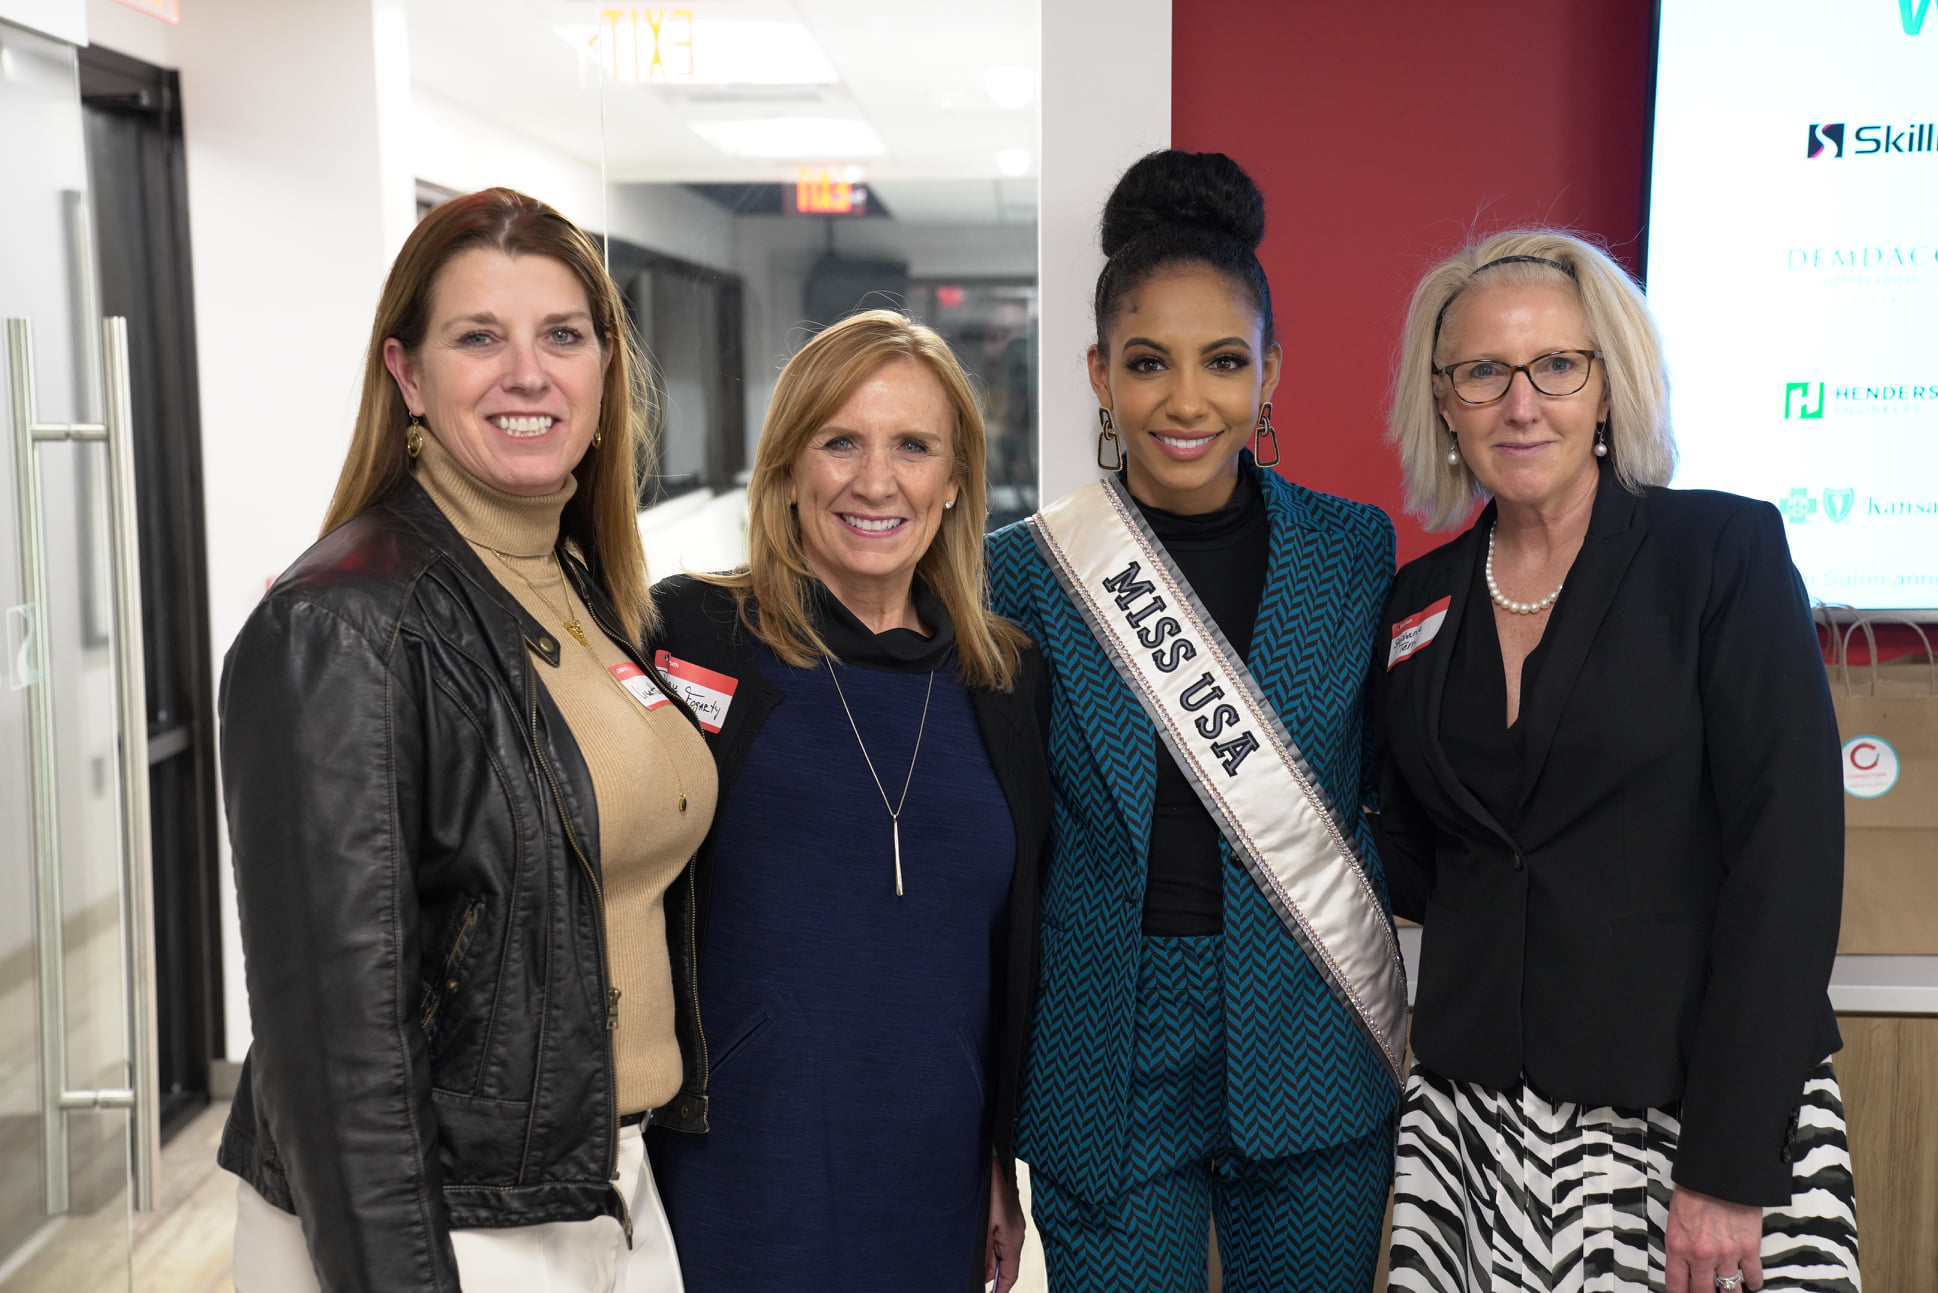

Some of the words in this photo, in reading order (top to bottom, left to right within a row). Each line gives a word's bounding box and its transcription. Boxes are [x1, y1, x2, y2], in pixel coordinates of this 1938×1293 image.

[1855, 123, 1938, 154] Skill
[1787, 245, 1938, 269] DEMDAC
[1823, 570, 1886, 587] Salon
[1892, 575, 1938, 586] ann
[1102, 561, 1197, 673] MISS
[1179, 671, 1260, 777] USA
